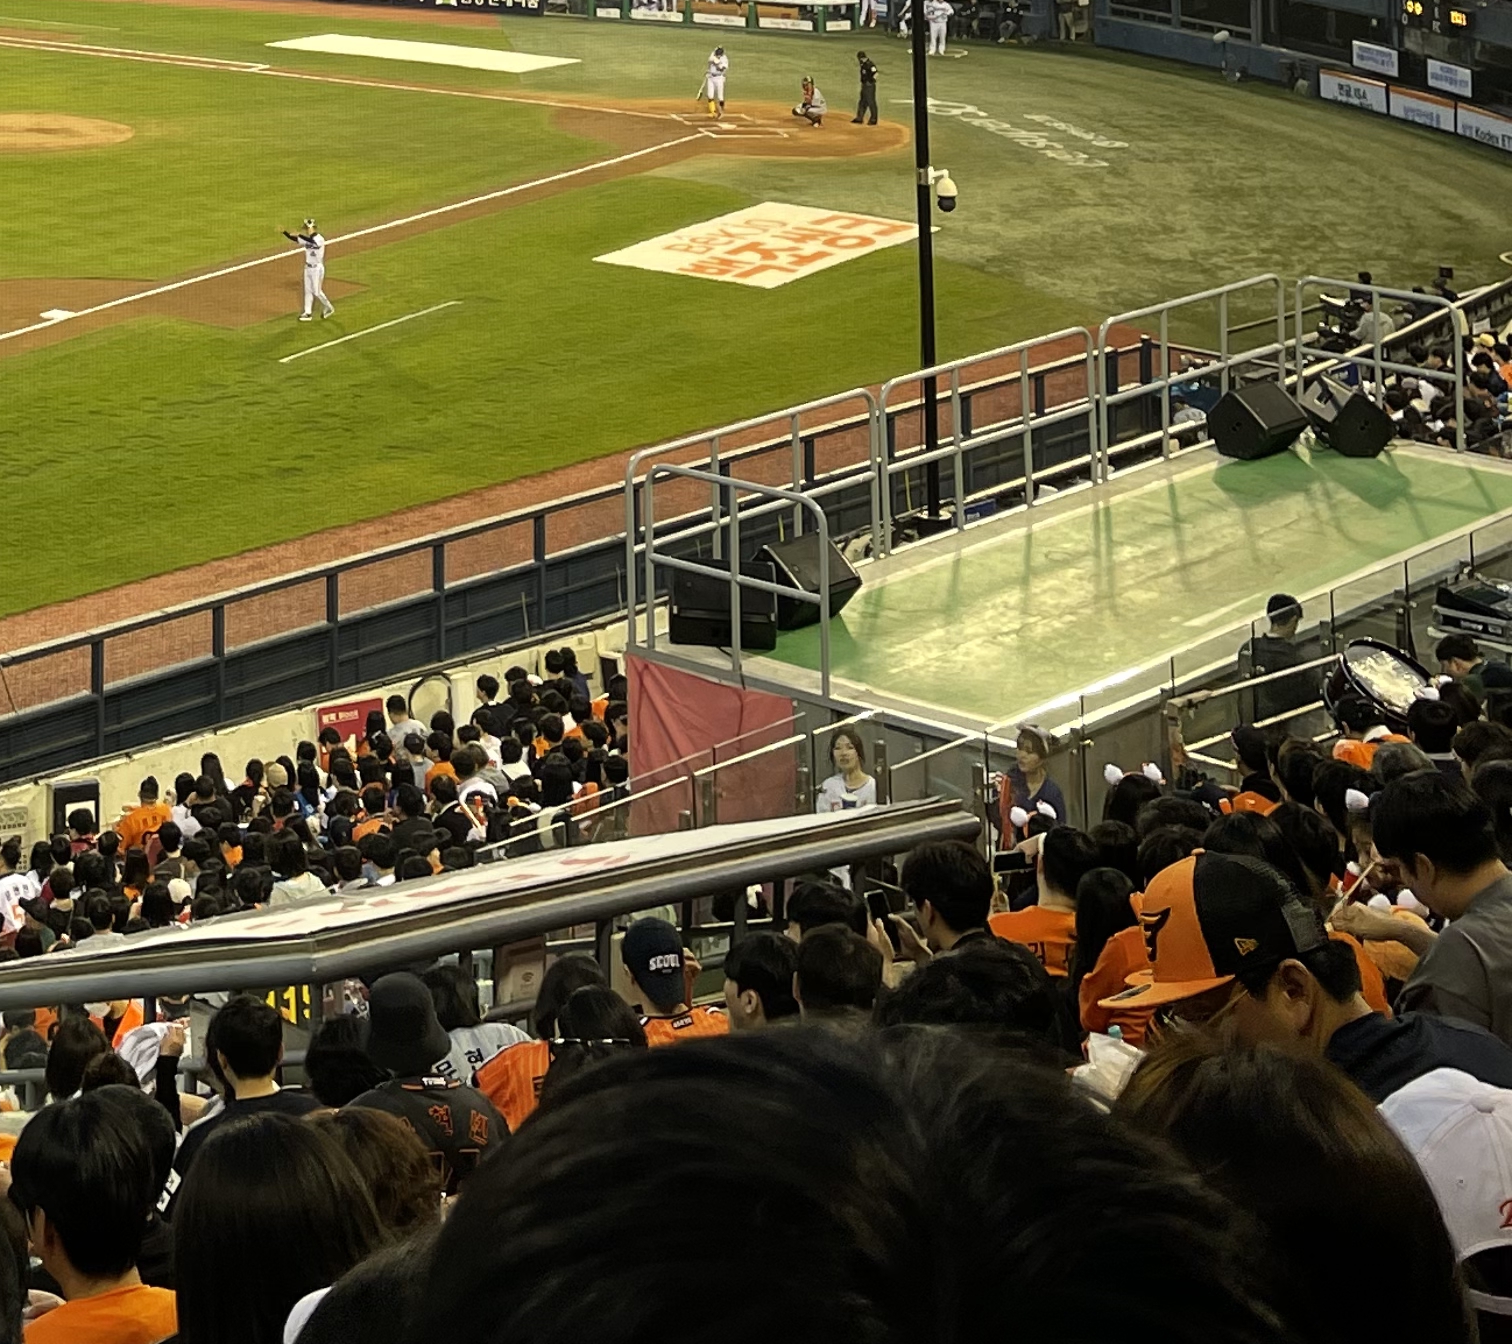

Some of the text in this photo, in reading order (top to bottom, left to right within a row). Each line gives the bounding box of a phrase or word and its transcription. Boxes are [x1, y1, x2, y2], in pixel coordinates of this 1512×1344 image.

[1474, 125, 1499, 145] Kodex
[676, 214, 916, 279] 백조씽크
[649, 953, 681, 972] SEOUL
